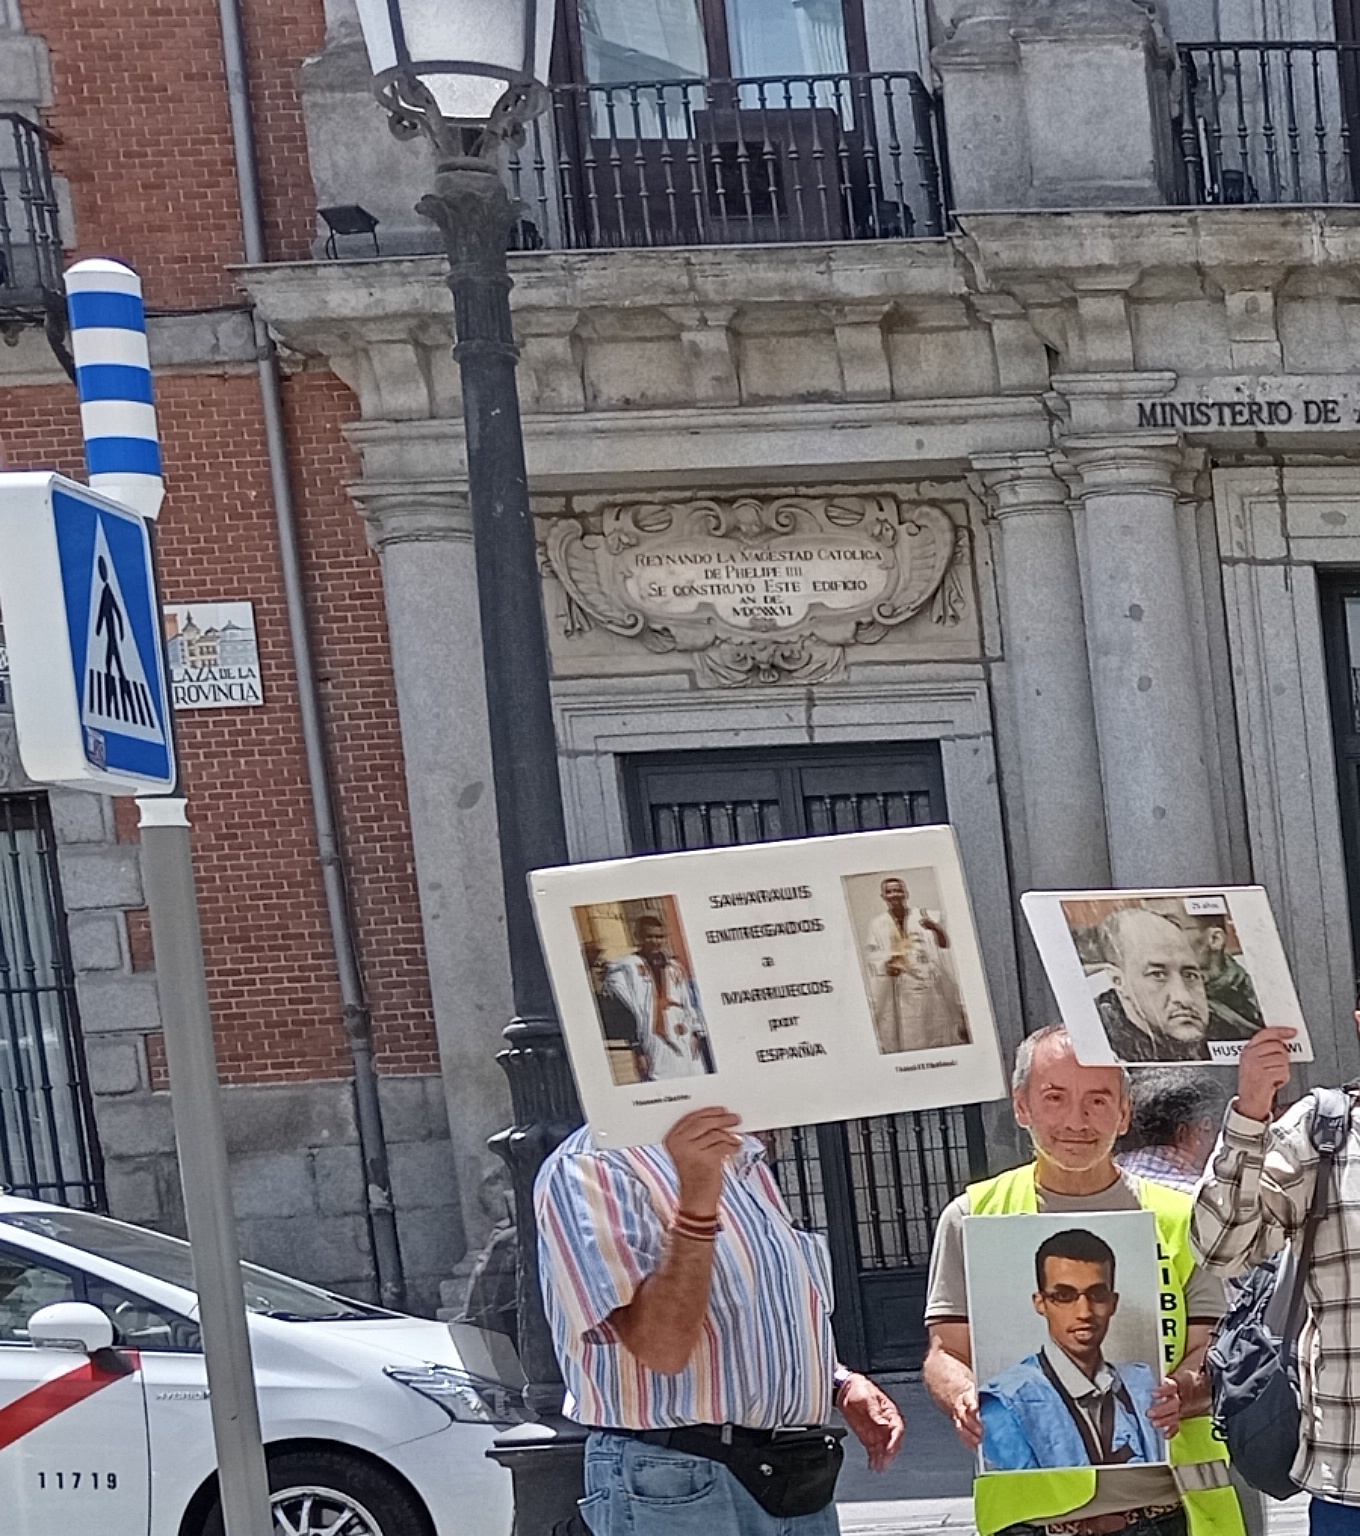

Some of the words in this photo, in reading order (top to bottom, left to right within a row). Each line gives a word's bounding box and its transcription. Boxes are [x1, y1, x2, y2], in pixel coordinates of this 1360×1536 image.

[1137, 399, 1292, 428] MINISTERIO
[1303, 399, 1341, 425] DE
[634, 552, 712, 568] REYNANDO
[717, 552, 736, 564] LA
[740, 550, 814, 564] MAGESTAD
[817, 549, 882, 562] CATOLICA
[704, 568, 722, 581] DE
[725, 565, 782, 580] PHELIPE
[648, 582, 667, 598] SE
[673, 582, 756, 597] CONSTRUYO
[764, 579, 802, 593] ESTE
[812, 580, 868, 592] EDIFICIO
[170, 667, 219, 683] LAZA
[219, 667, 236, 680] DE
[238, 666, 257, 680] LA
[174, 681, 261, 705] ROVINCIA
[708, 885, 813, 909] SAHARAUIS
[705, 918, 826, 944] ENTREGADOS
[720, 979, 834, 1006] MARRUECOS
[768, 1015, 801, 1032] por
[755, 1040, 828, 1063] ESPAÑA
[1157, 1243, 1177, 1363] LIBRE
[37, 1471, 117, 1490] 11719
